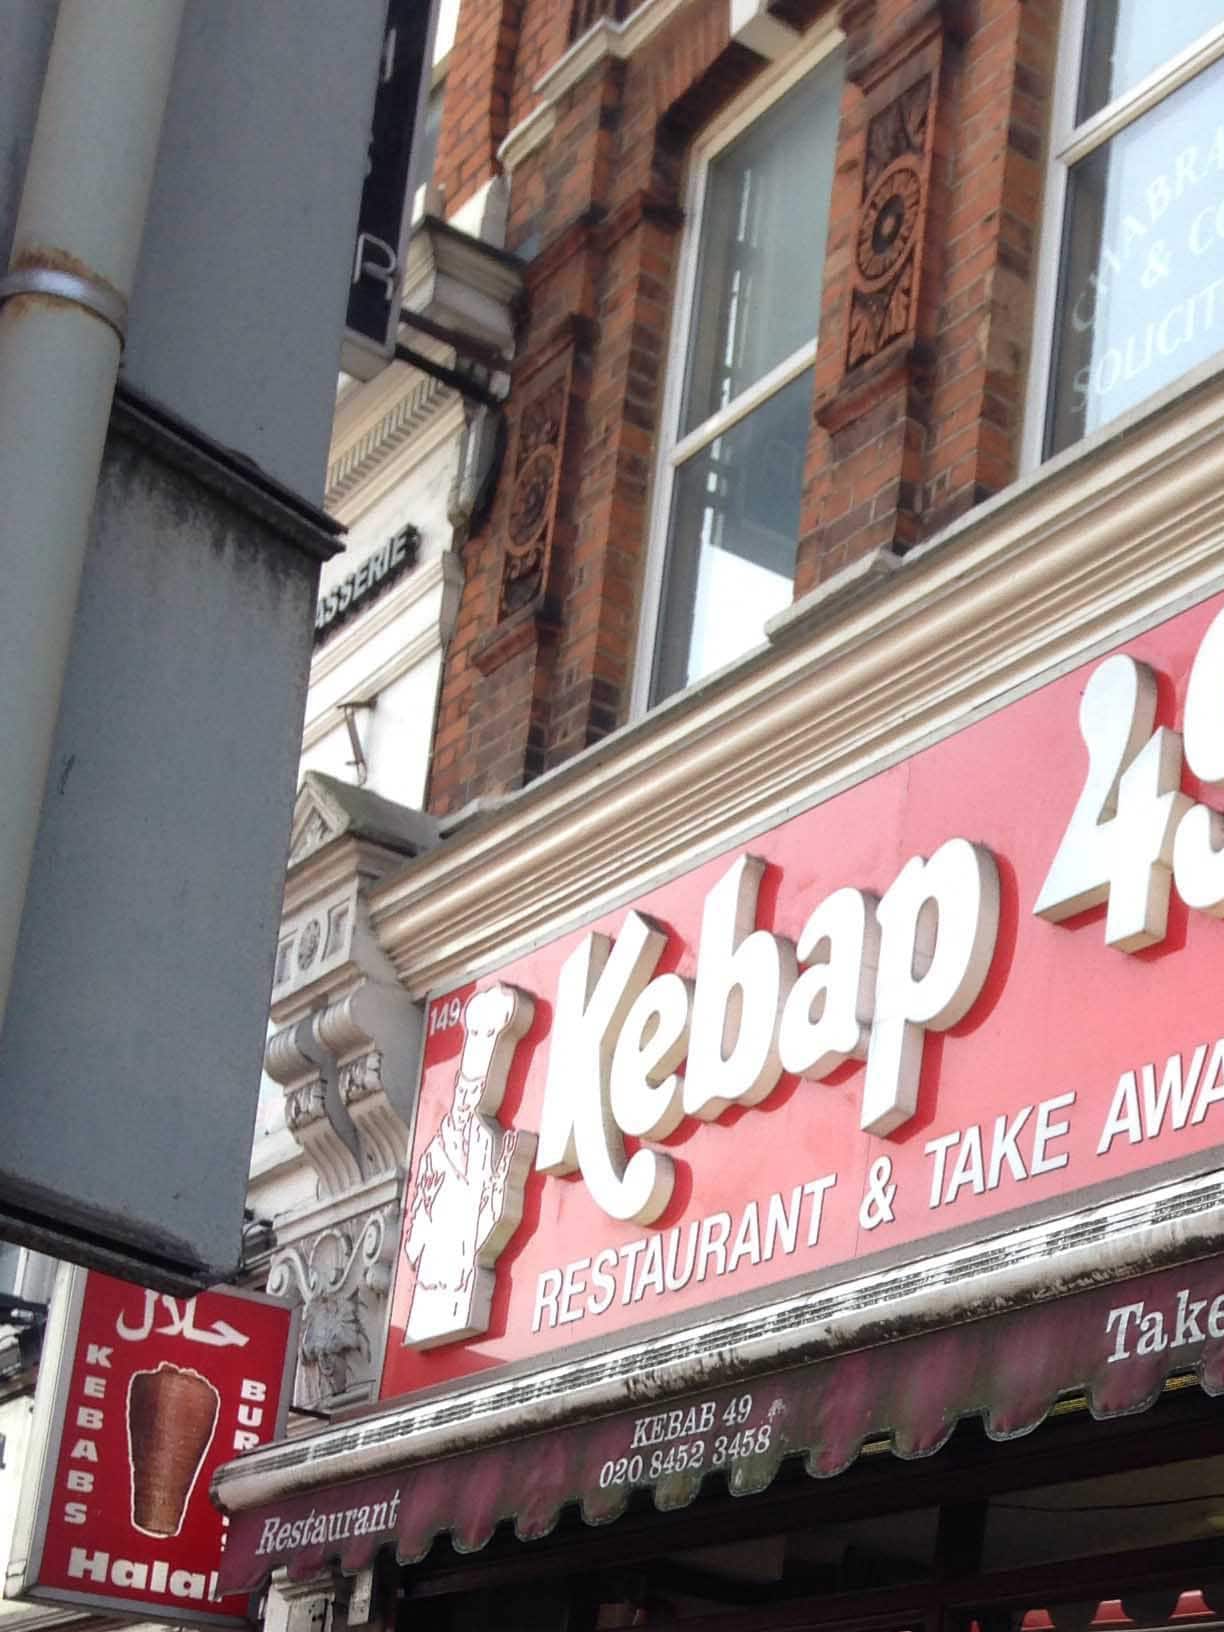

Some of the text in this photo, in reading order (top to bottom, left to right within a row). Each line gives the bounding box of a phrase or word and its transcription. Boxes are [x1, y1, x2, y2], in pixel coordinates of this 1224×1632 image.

[429, 998, 461, 1037] 149
[536, 852, 1002, 1228] Kebap
[530, 1175, 836, 1335] RESTAURANT
[857, 1154, 898, 1231] &
[924, 1090, 1076, 1205] TAKE
[64, 1343, 112, 1527] KEBABS
[630, 1394, 753, 1449] KEBAB 49
[600, 1424, 772, 1489] 020 8452 3458
[256, 1489, 402, 1556] Restaurant
